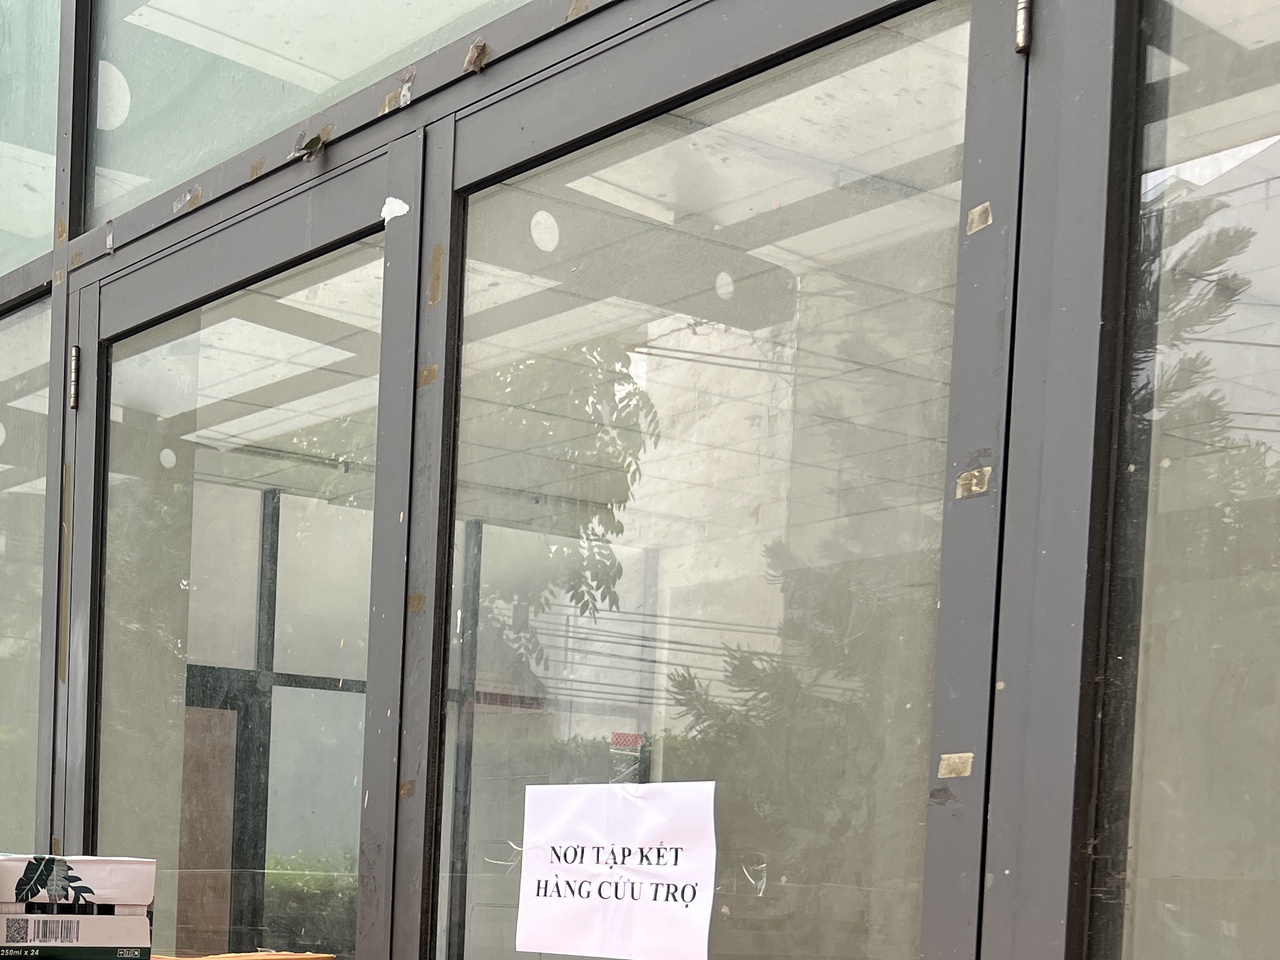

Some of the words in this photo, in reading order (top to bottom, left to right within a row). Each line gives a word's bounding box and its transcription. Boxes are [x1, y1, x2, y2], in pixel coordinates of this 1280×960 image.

[549, 845, 587, 865] NƠI
[592, 844, 632, 870] TẬP
[638, 841, 684, 866] KẾT
[535, 874, 592, 900] HÀNG
[597, 876, 644, 901] CỨU
[649, 882, 699, 909] TRỢ
